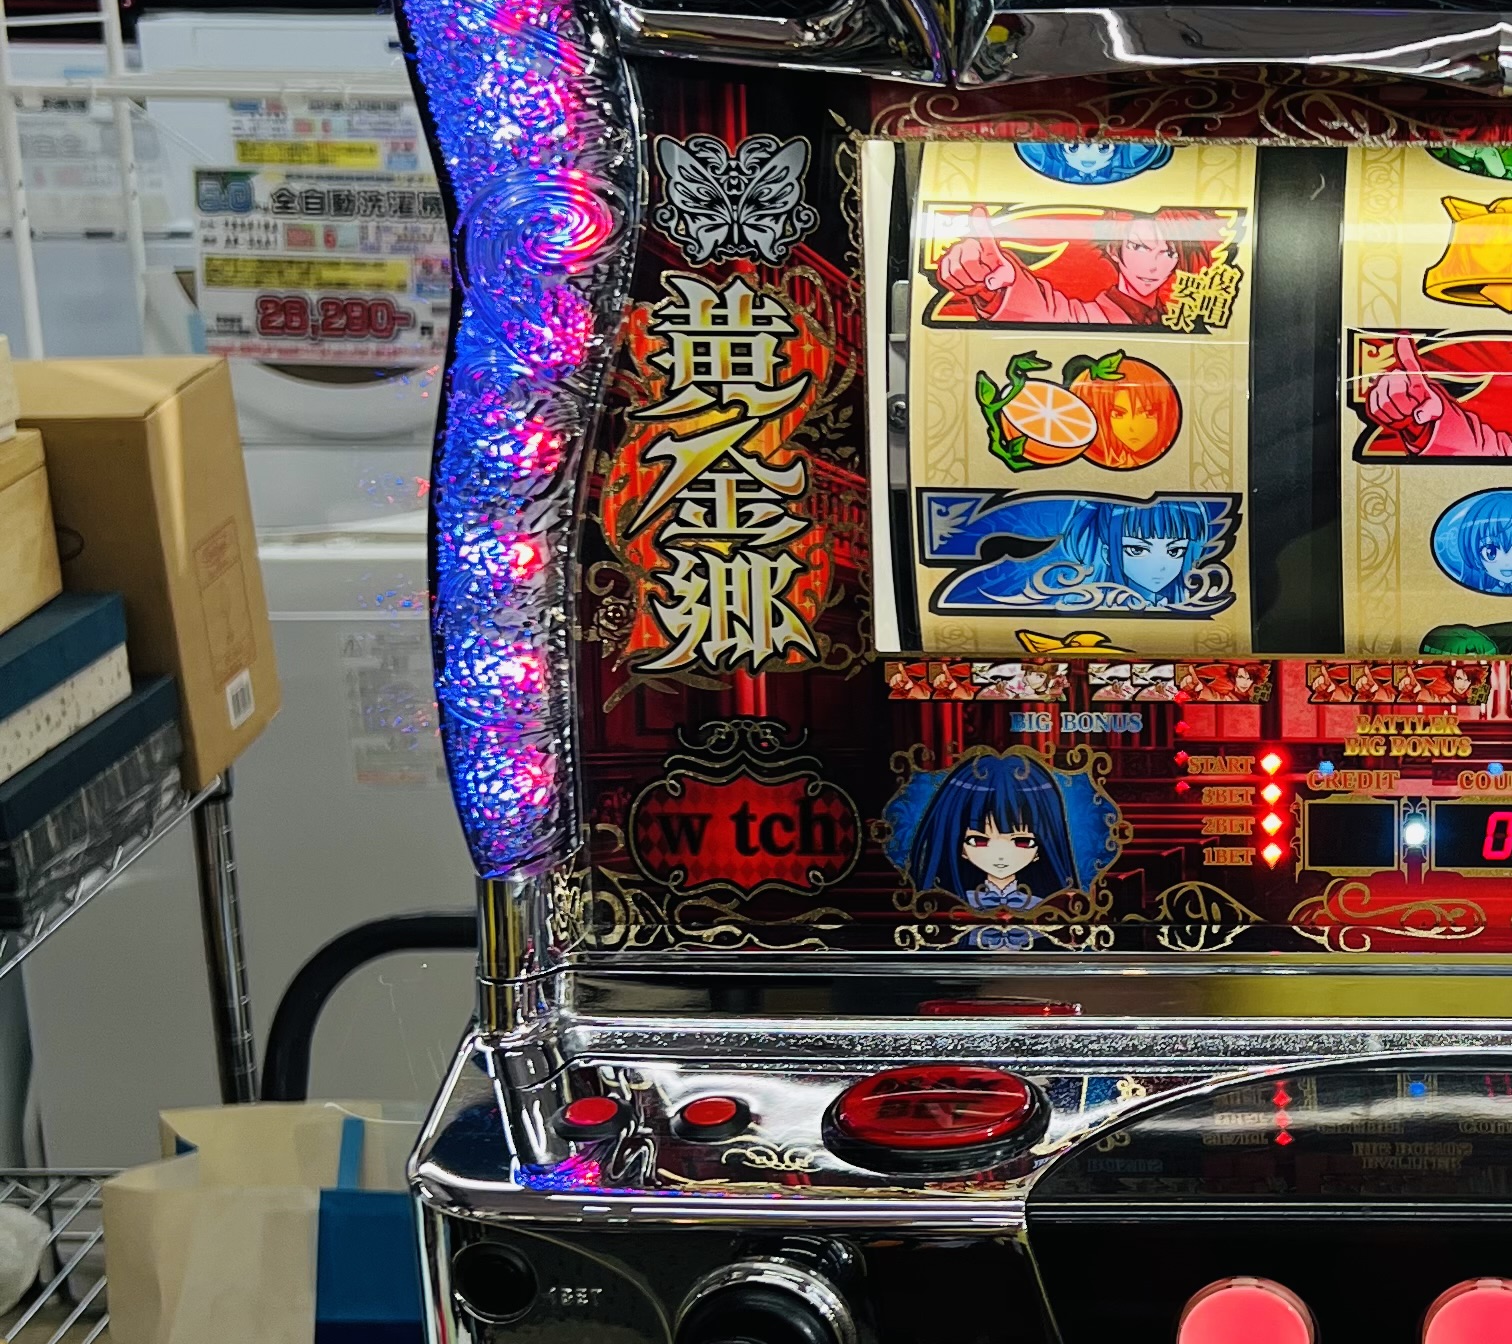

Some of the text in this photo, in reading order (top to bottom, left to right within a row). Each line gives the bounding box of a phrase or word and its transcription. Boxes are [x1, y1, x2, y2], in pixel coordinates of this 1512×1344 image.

[631, 272, 817, 674] 黄金郷
[1009, 711, 1143, 734] BIG BONUS
[1355, 714, 1462, 736] BATTLER
[1343, 736, 1473, 758] BIG BONUS
[1187, 756, 1256, 774] START
[1306, 770, 1400, 791] CREDIT
[1201, 787, 1256, 805] 3BET
[1201, 816, 1256, 835] 2BET
[1202, 848, 1256, 866] 1BET
